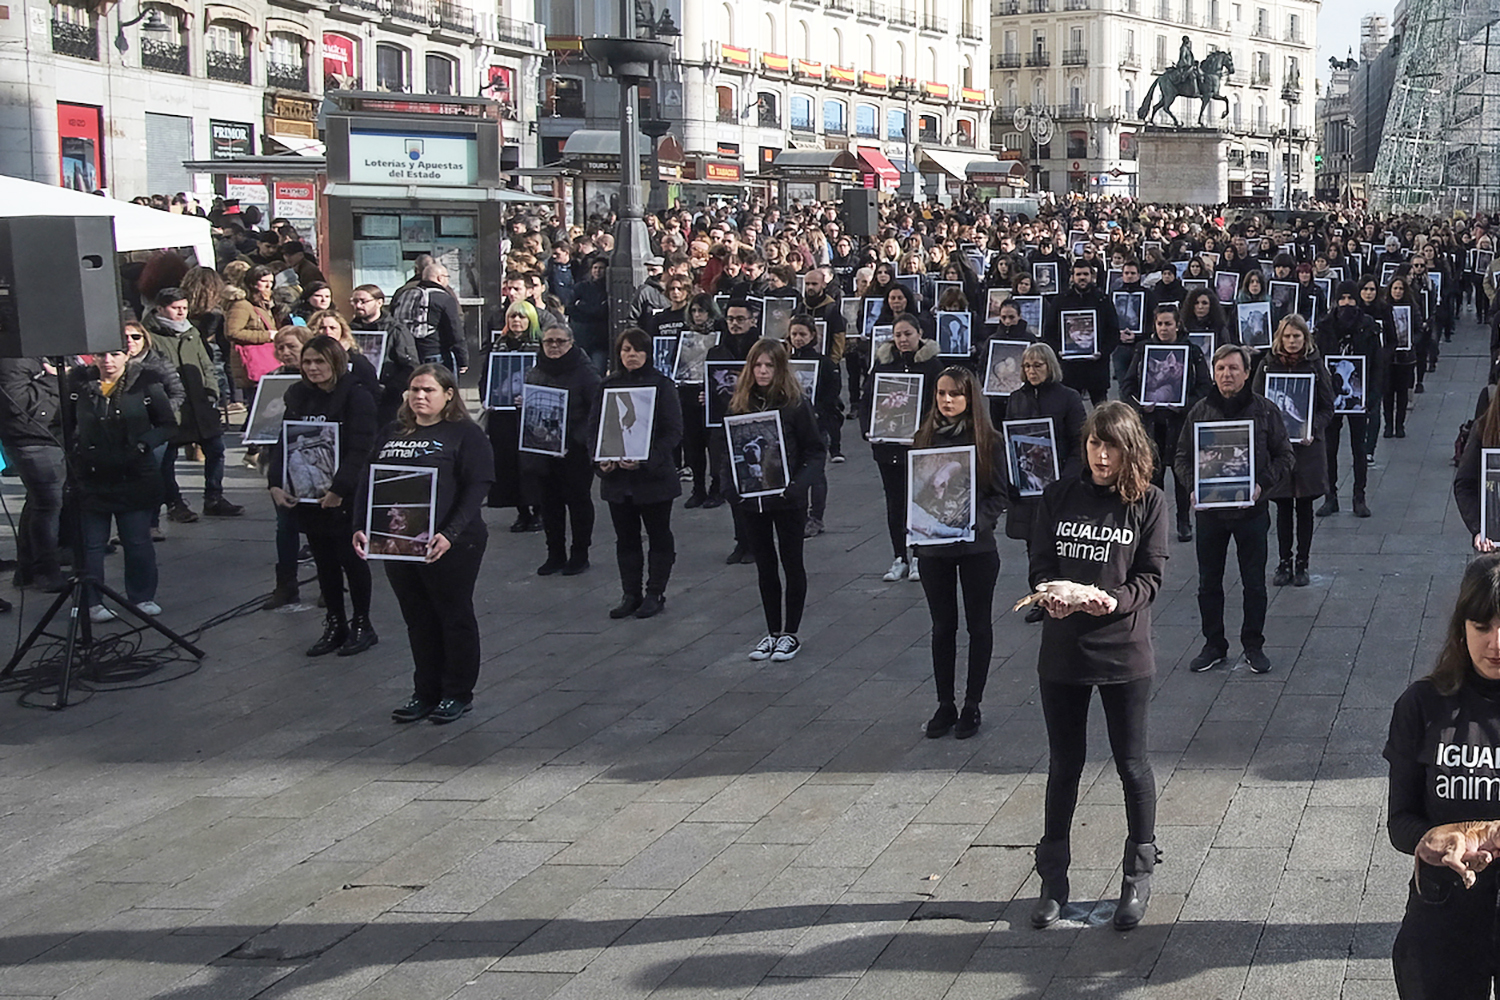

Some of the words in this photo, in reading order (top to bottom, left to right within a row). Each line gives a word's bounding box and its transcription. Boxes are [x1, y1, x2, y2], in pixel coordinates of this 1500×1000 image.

[213, 126, 247, 140] PRIMOR
[364, 159, 406, 168] Loterías
[408, 161, 416, 169] y
[417, 161, 464, 170] Apuestas
[388, 170, 404, 178] del
[406, 170, 441, 179] Estado
[1056, 521, 1134, 545] IGUALDAD
[1055, 538, 1111, 563] animal
